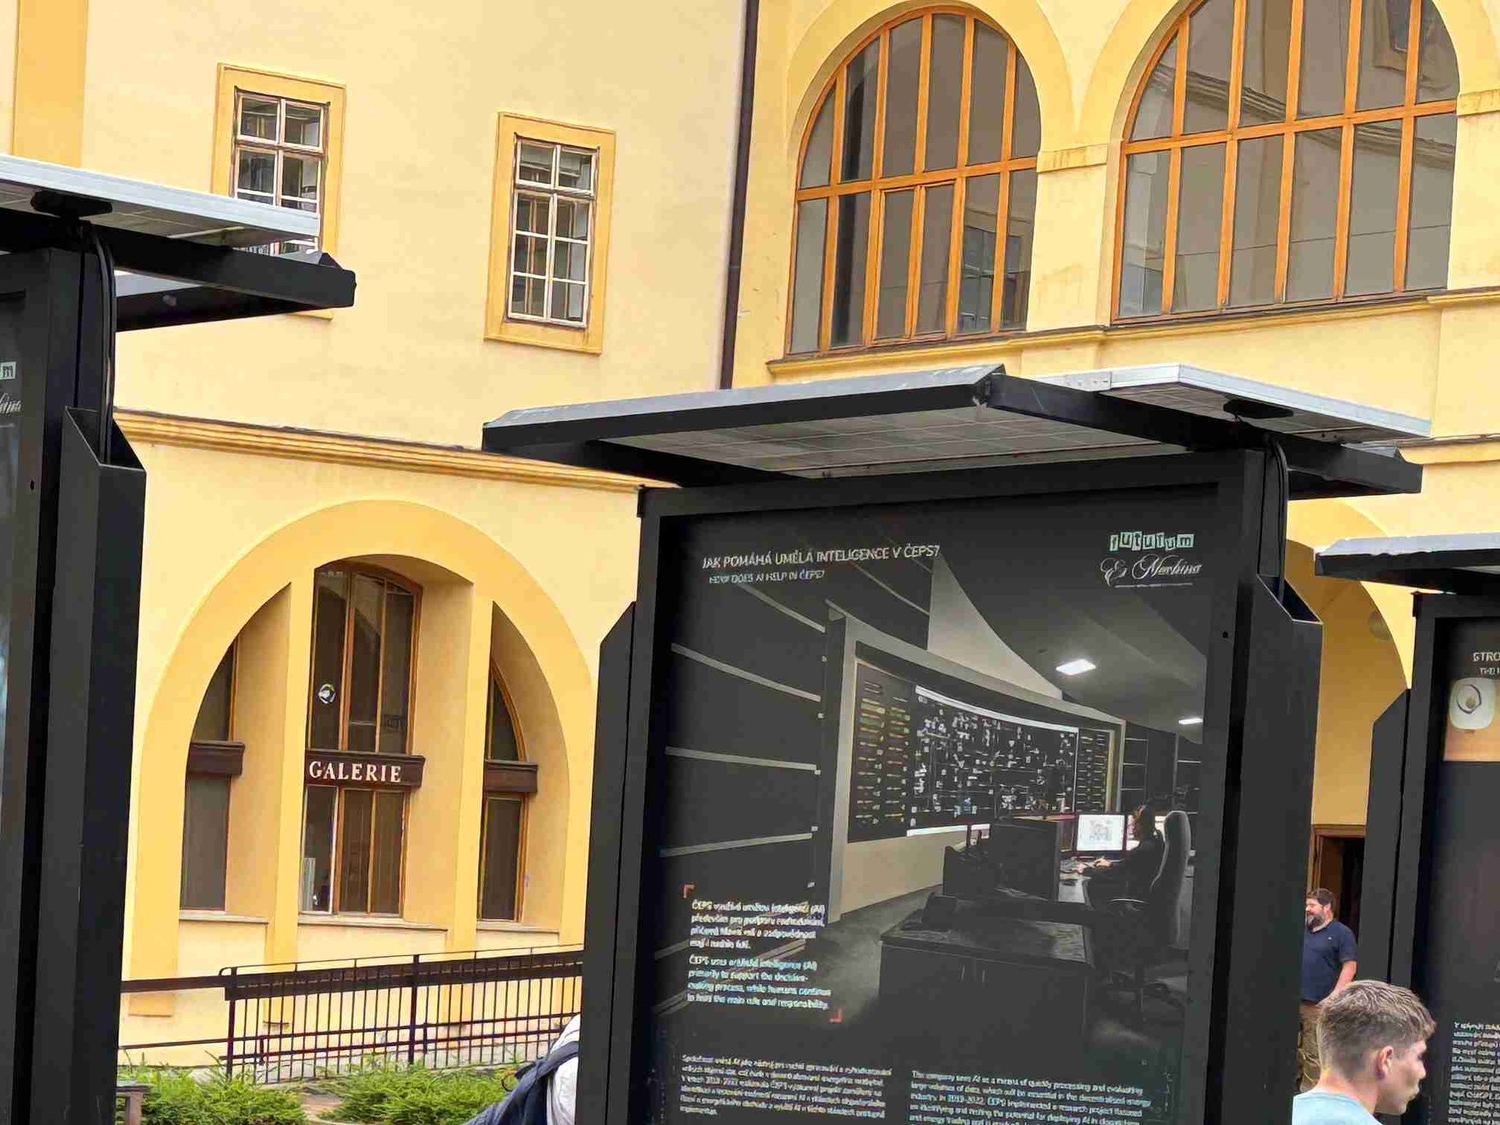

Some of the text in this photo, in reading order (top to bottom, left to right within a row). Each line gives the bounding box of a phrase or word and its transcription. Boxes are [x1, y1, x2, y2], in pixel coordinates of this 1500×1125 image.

[703, 557, 721, 569] JAK
[724, 551, 772, 567] POMÁHÁ
[816, 547, 889, 564] INTELIGENCE
[892, 547, 902, 559] V
[309, 761, 402, 783] GALERIE
